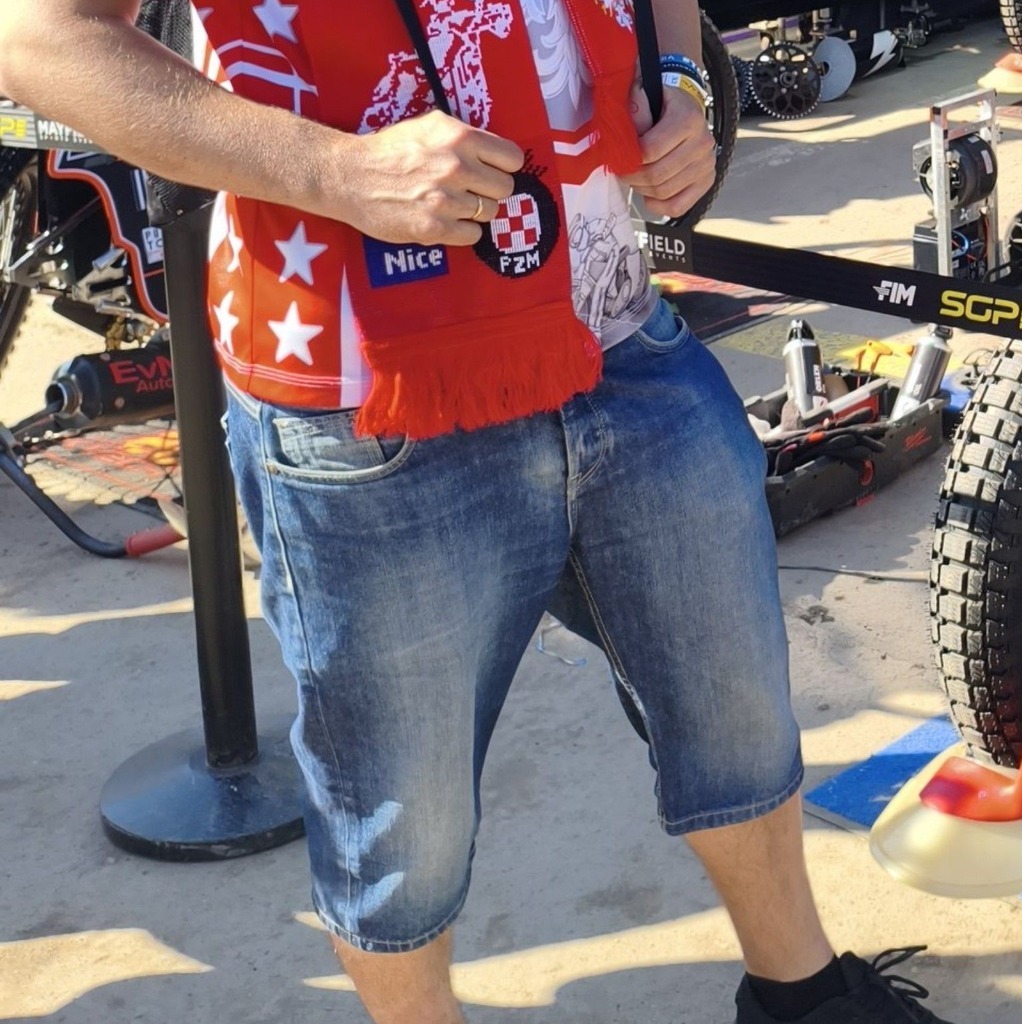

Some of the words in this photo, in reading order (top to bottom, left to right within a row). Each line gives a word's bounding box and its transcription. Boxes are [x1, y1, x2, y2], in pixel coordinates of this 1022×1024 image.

[637, 231, 685, 256] FIELD
[384, 249, 443, 276] Nice
[500, 250, 540, 272] PZM
[873, 280, 917, 307] FIM
[940, 291, 1020, 325] SGP
